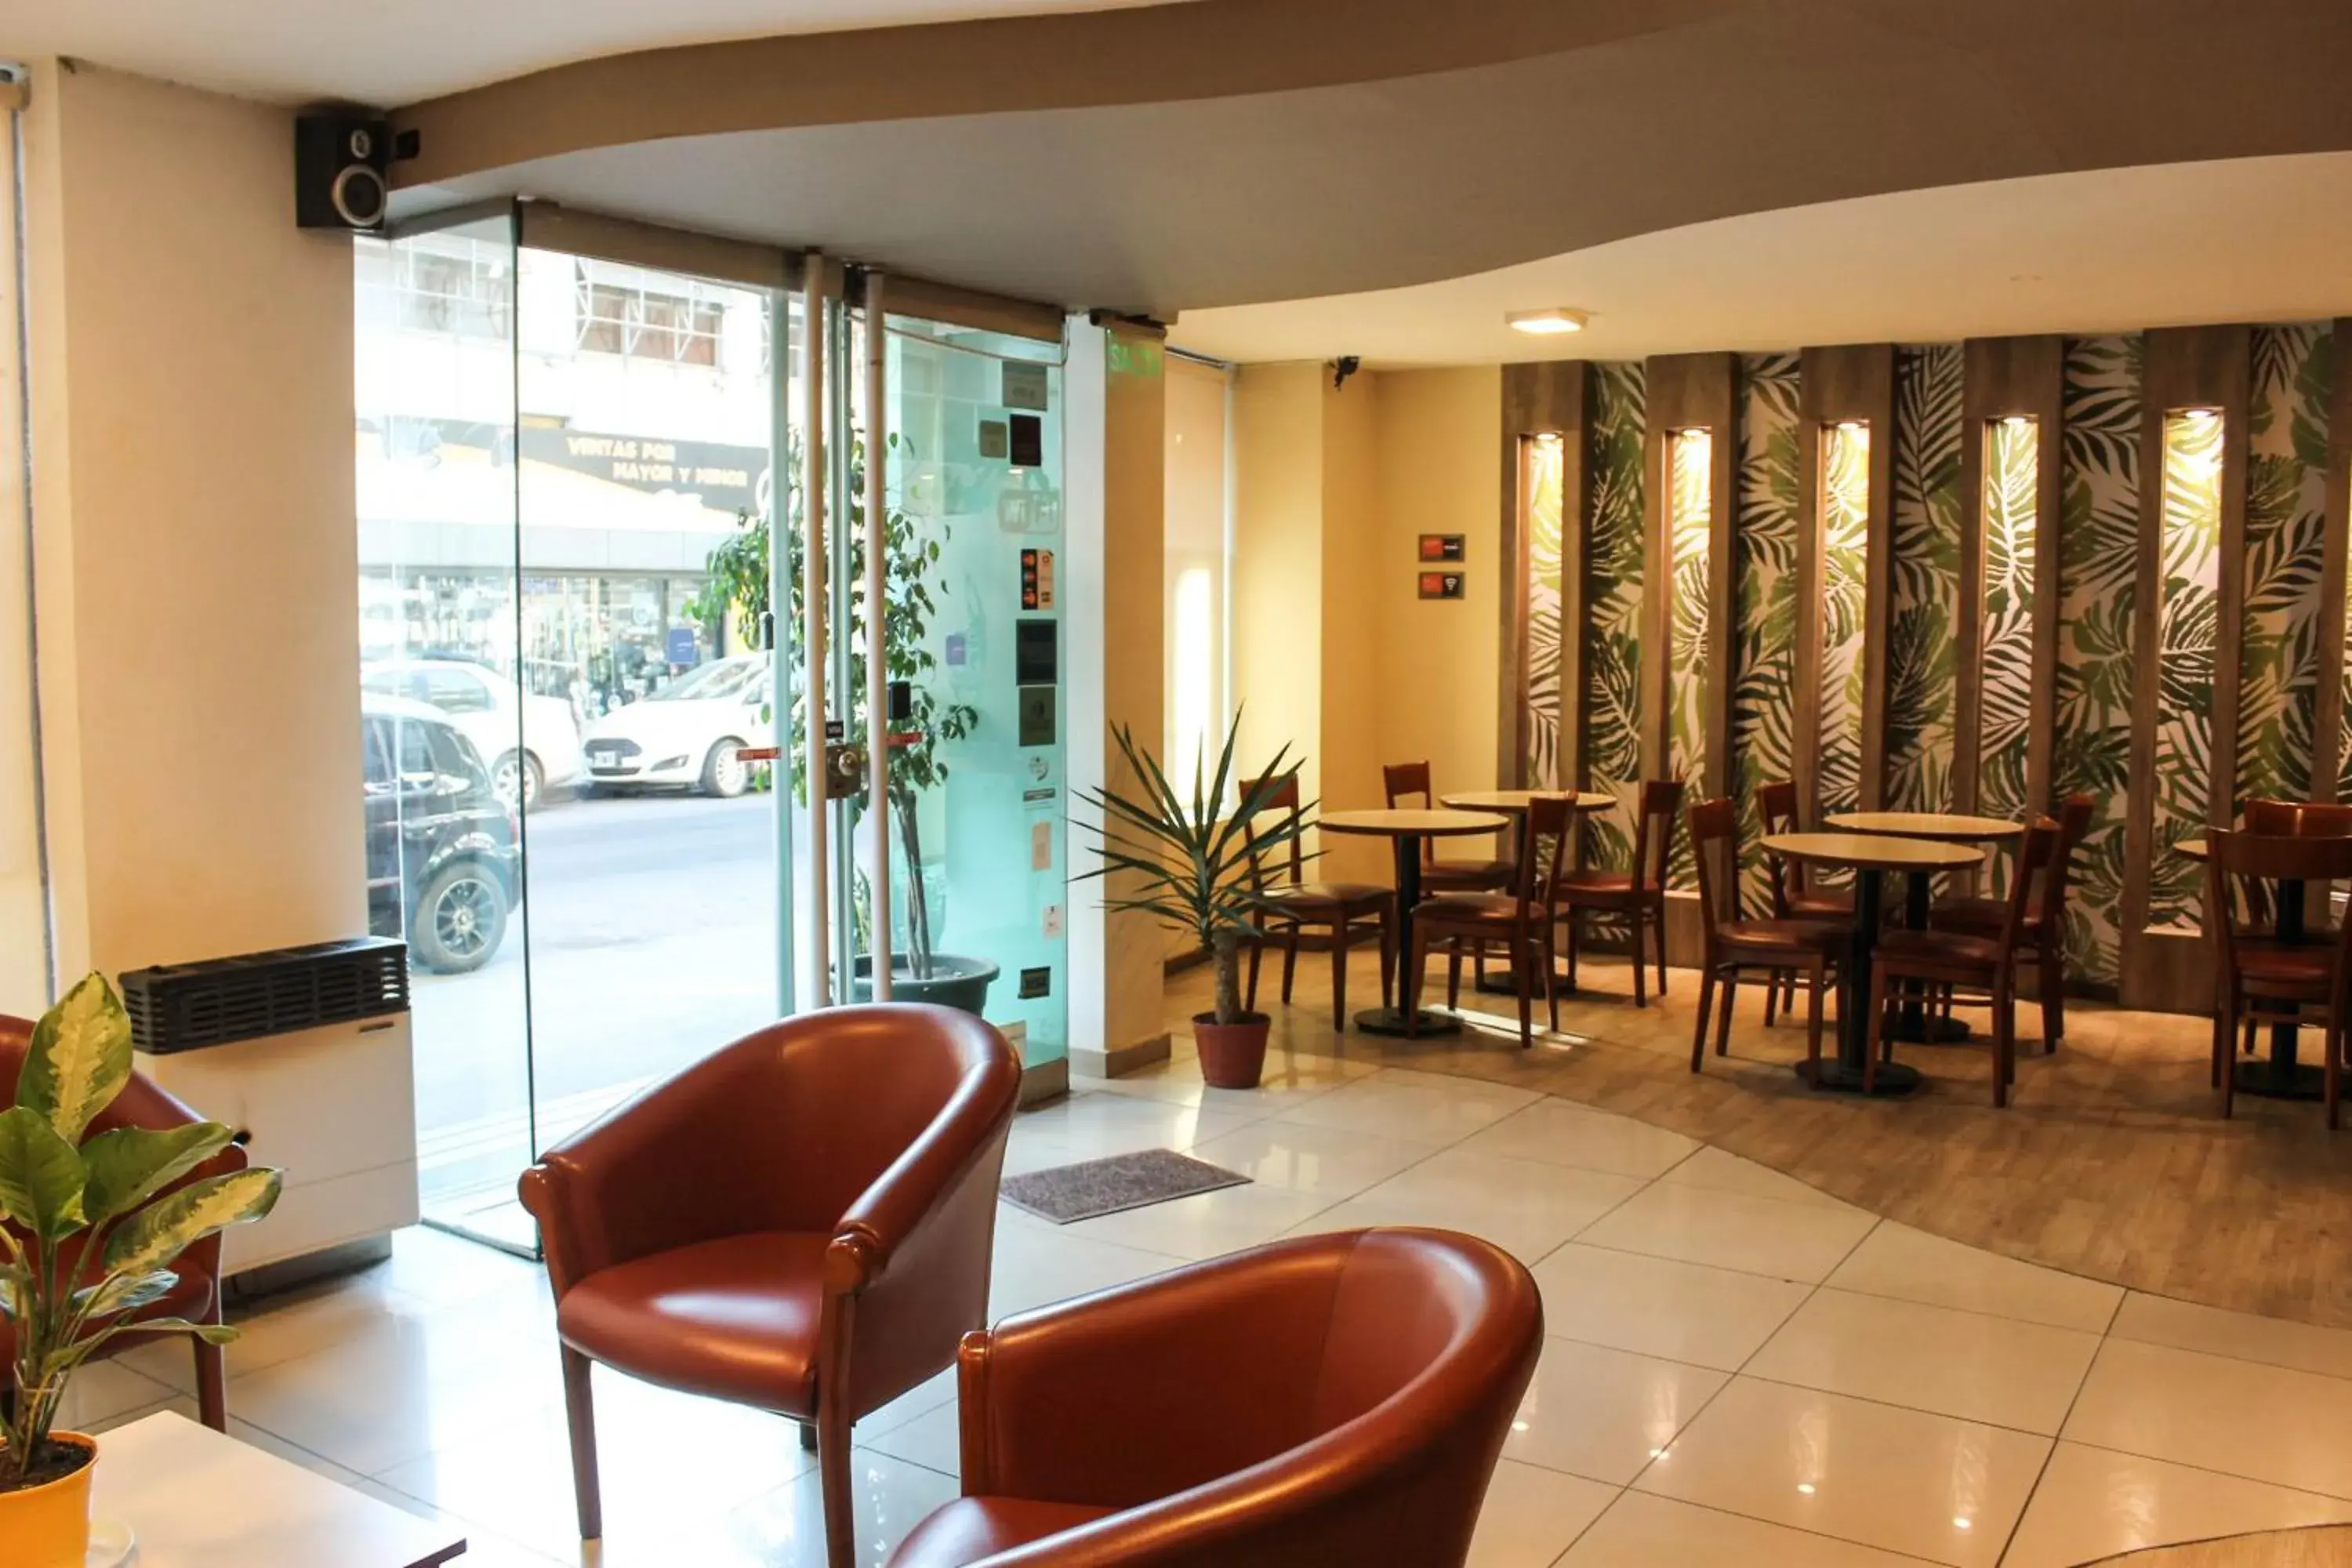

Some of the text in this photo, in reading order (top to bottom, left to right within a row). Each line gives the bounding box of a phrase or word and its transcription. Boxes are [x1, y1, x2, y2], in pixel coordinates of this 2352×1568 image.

[566, 437, 677, 463] VENTAS POR
[612, 461, 748, 488] MAYOR Y MENOR
